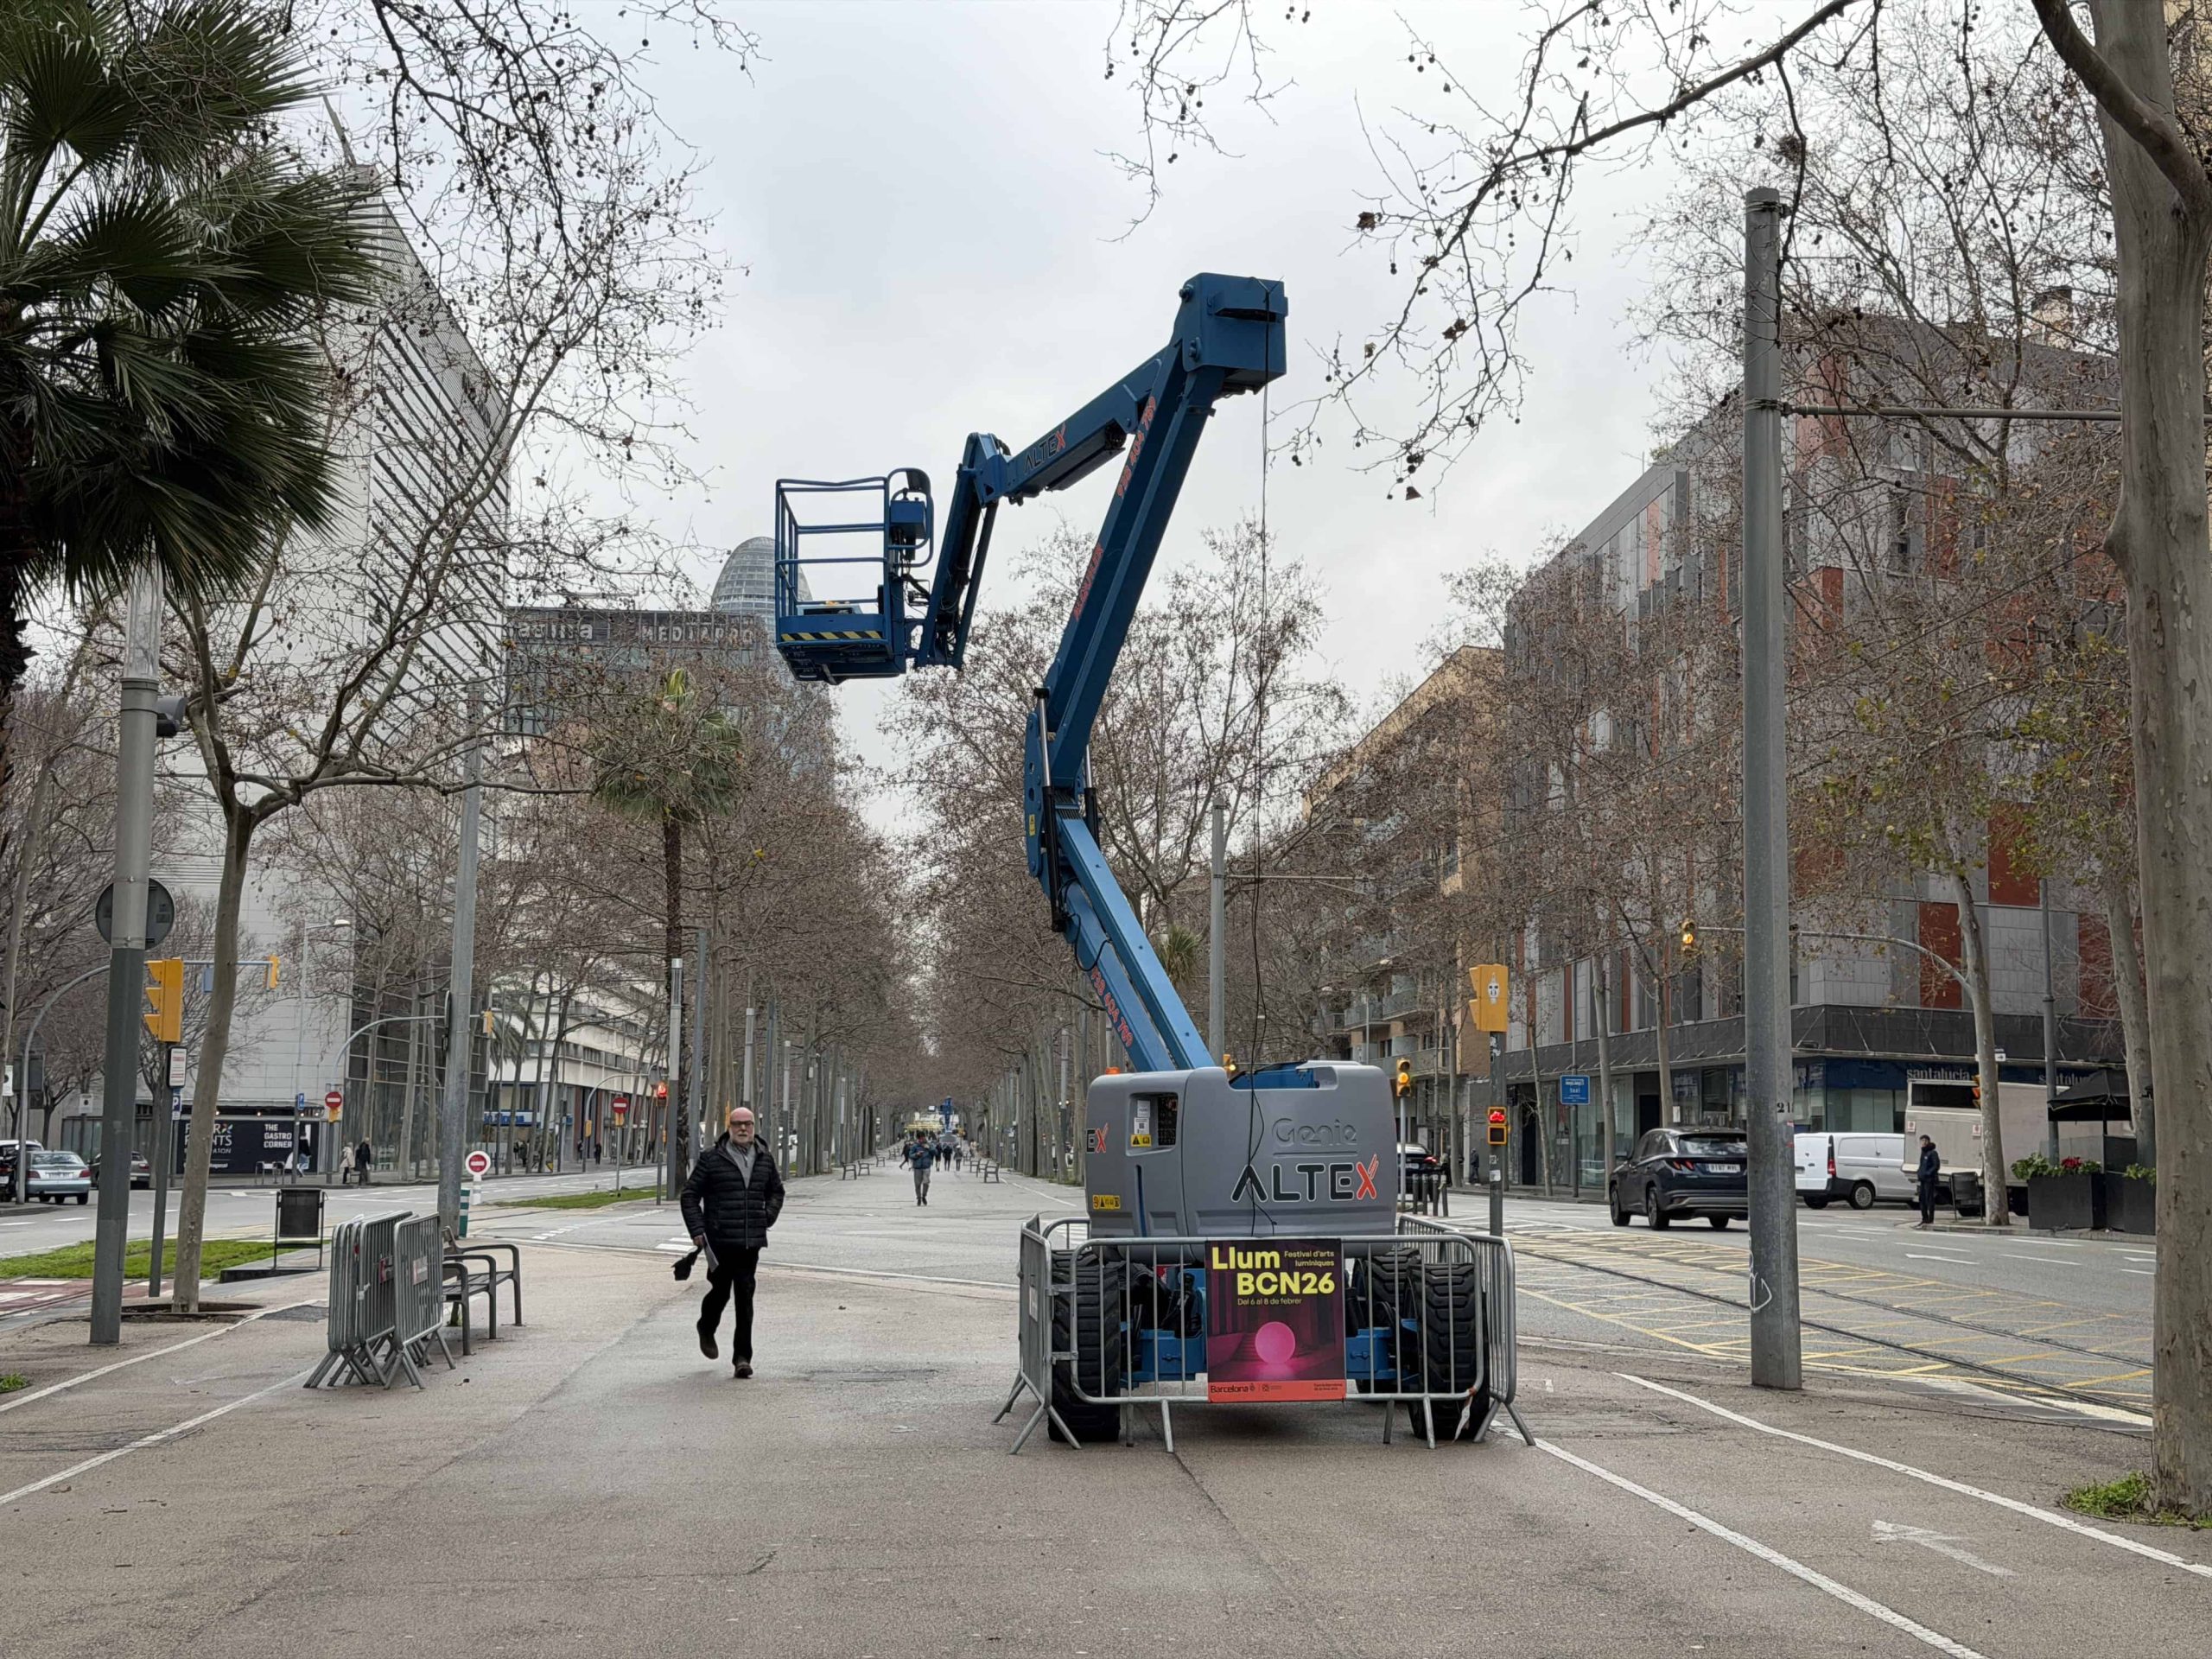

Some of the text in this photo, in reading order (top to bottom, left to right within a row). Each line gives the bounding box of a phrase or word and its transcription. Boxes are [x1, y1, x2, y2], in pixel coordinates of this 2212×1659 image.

[1023, 422, 1066, 476] ALTEX
[1272, 1117, 1358, 1147] Genie
[1230, 1154, 1380, 1202] ALTEX
[1212, 1247, 1281, 1269] Llum
[1236, 1272, 1335, 1295] BCN26
[1210, 1384, 1249, 1393] Barcelona
